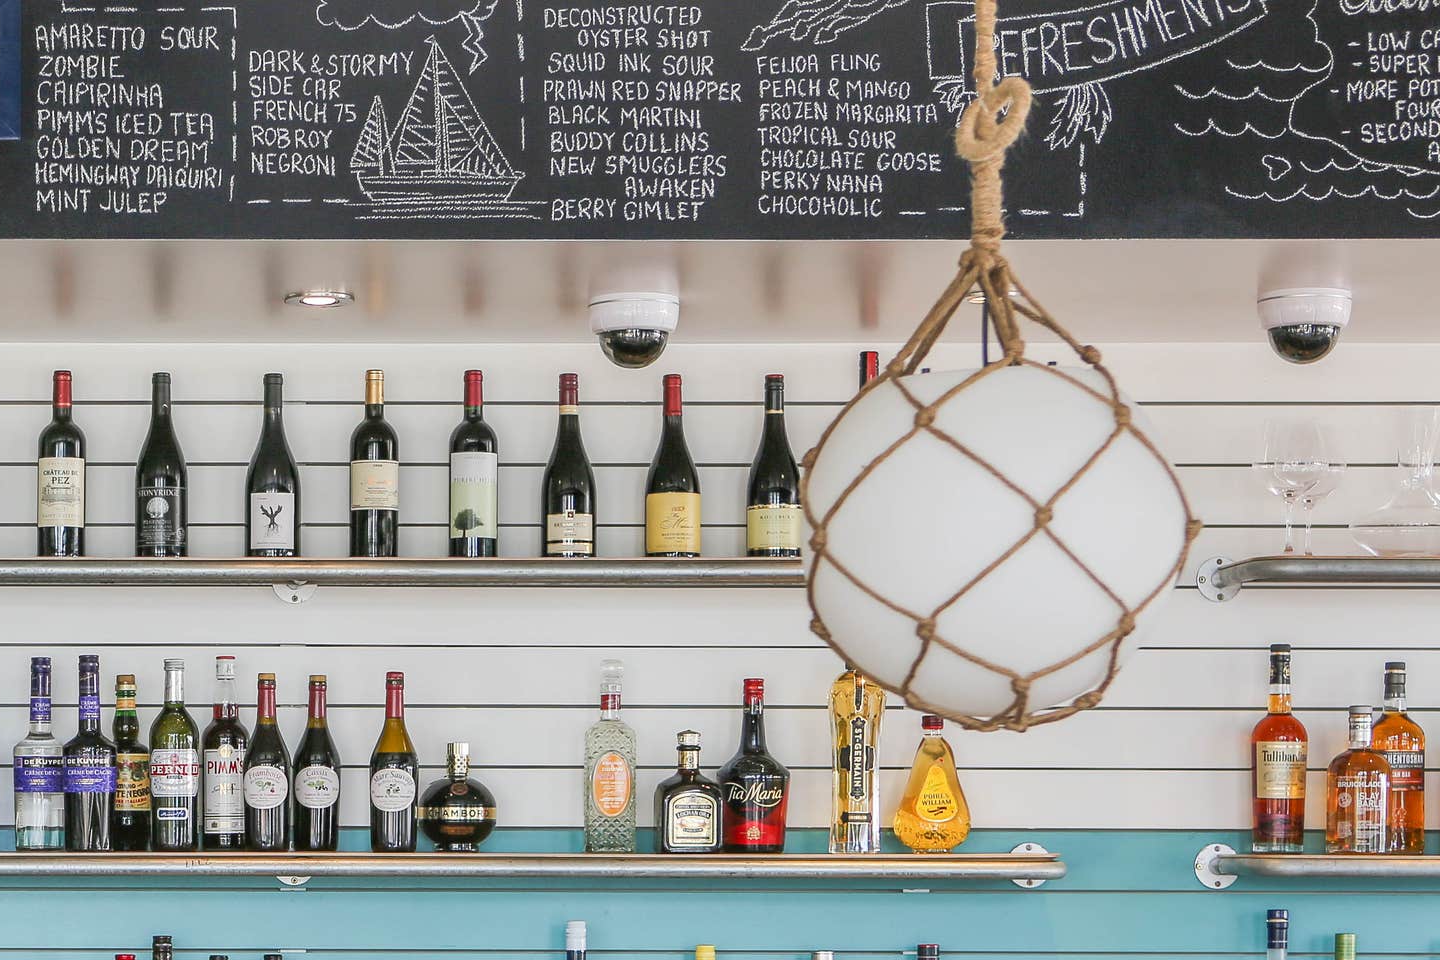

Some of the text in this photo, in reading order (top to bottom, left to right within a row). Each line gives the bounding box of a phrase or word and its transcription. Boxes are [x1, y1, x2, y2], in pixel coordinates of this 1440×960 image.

[544, 6, 701, 29] DECONSTRUCTED
[36, 25, 219, 50] AMARETTO SOUR
[578, 28, 710, 49] OYSTER SHOT
[1368, 32, 1410, 51] LOW
[39, 55, 124, 80] ZOMBIE
[249, 50, 305, 74] DARK
[326, 52, 413, 79] STORMY
[548, 52, 713, 76] SQUID INK SOUR
[757, 54, 880, 74] FEIJOA FLING
[1370, 54, 1430, 74] SUPER
[37, 81, 162, 109] CAIPIRINHA
[249, 75, 340, 101] SIDE CAR
[544, 80, 741, 104] PRAWN RED SNAPPER
[760, 78, 910, 103] PEACH & MANGO
[1347, 80, 1400, 103] MORE
[38, 110, 213, 138] PIMM'S ICED TEA
[254, 100, 356, 124] FRENCH 75
[549, 105, 701, 128] BLACK MARTINI
[760, 102, 937, 125] FROZEN MARGARITA
[551, 132, 708, 155] BUDDY COLLINS
[758, 126, 895, 151] TROPICAL SOUR
[37, 136, 211, 167] GOLDEN DREAM
[761, 150, 941, 174] CHOCOLATE GOOSE
[252, 153, 335, 175] NEGRONI
[551, 154, 726, 179] NEW SMUGGLERS
[36, 163, 222, 191] HEMINGWAY DAIQUIRI
[625, 176, 714, 200] AWAKEN
[761, 171, 882, 192] PERKY NANA
[37, 189, 167, 213] MINT JULEP
[552, 199, 703, 220] BERRY GIMLET
[759, 196, 881, 216] CHOCOHOLIC
[51, 477, 70, 485] PEZ
[151, 765, 198, 775] PERND
[724, 781, 783, 806] Tia Maria
[428, 808, 490, 818] CHAMBORD
